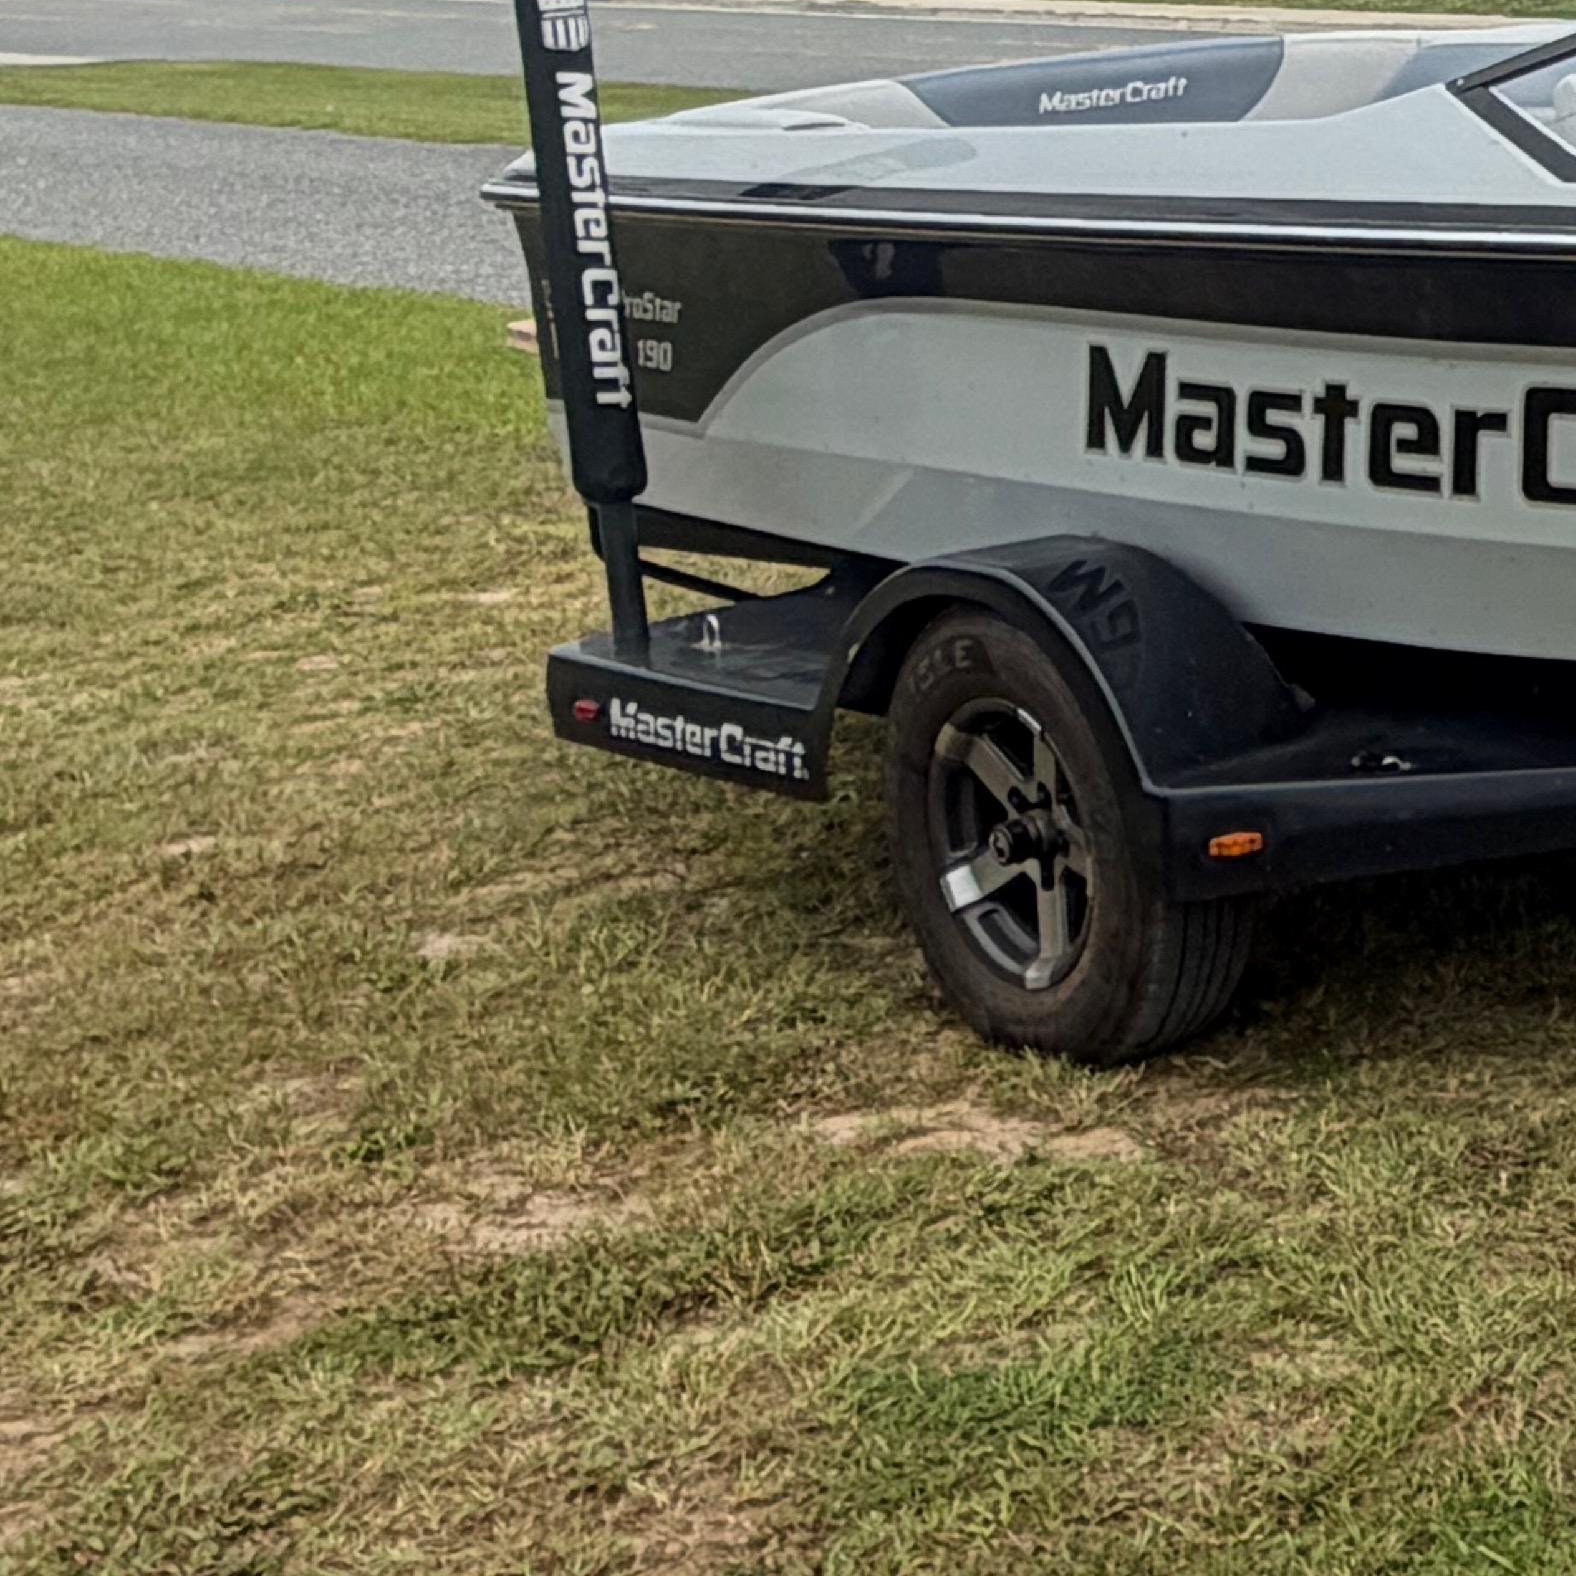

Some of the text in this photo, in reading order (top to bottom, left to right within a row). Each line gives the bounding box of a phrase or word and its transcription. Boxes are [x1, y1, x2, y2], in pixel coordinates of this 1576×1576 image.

[1038, 75, 1188, 115] MasterCraft
[555, 71, 632, 409] MasterCraft
[622, 290, 682, 324] roStar
[637, 338, 673, 372] 190
[610, 696, 807, 779] MasterCraft
